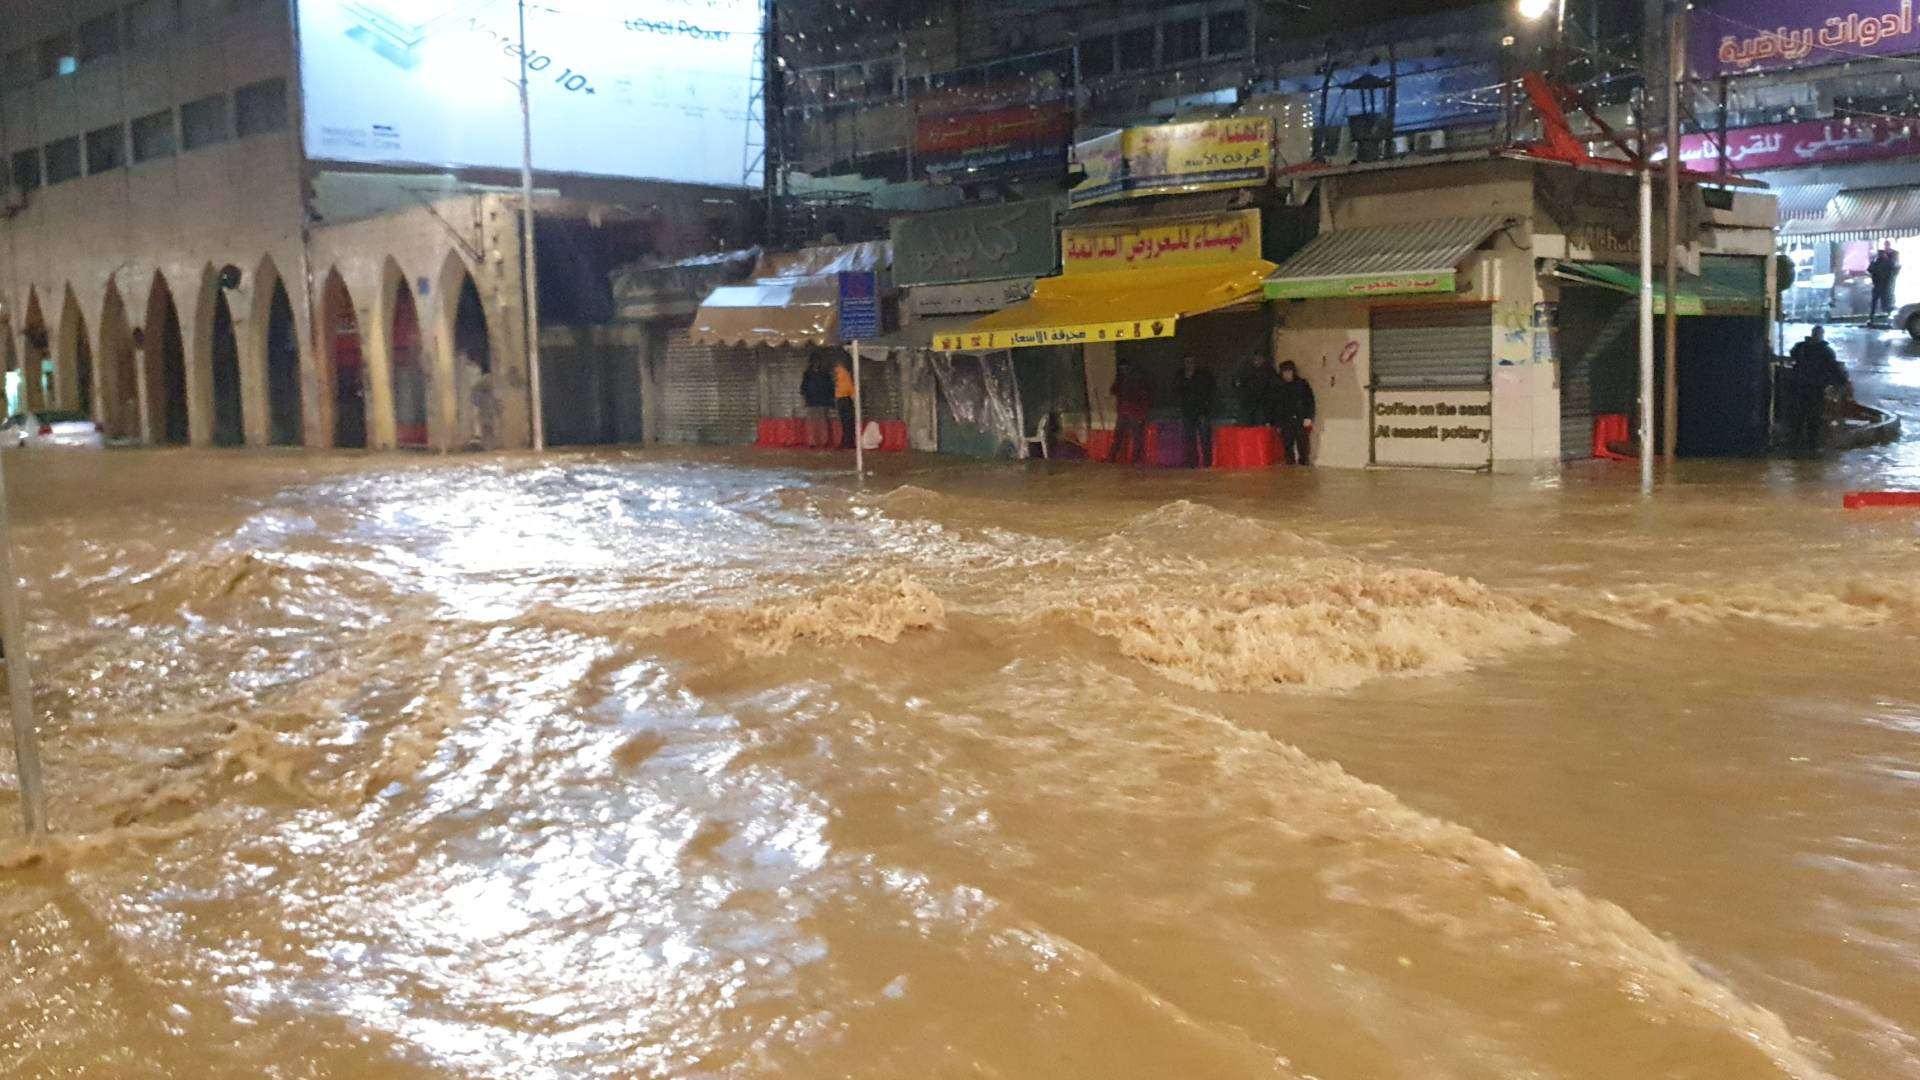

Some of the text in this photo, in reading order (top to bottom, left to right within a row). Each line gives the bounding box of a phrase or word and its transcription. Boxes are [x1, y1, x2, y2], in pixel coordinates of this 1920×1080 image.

[1719, 0, 1912, 67] أدوات رياضية
[555, 68, 596, 95] 10+
[1376, 402, 1417, 416] Coffee
[1420, 405, 1434, 416] on
[1436, 402, 1456, 416] the
